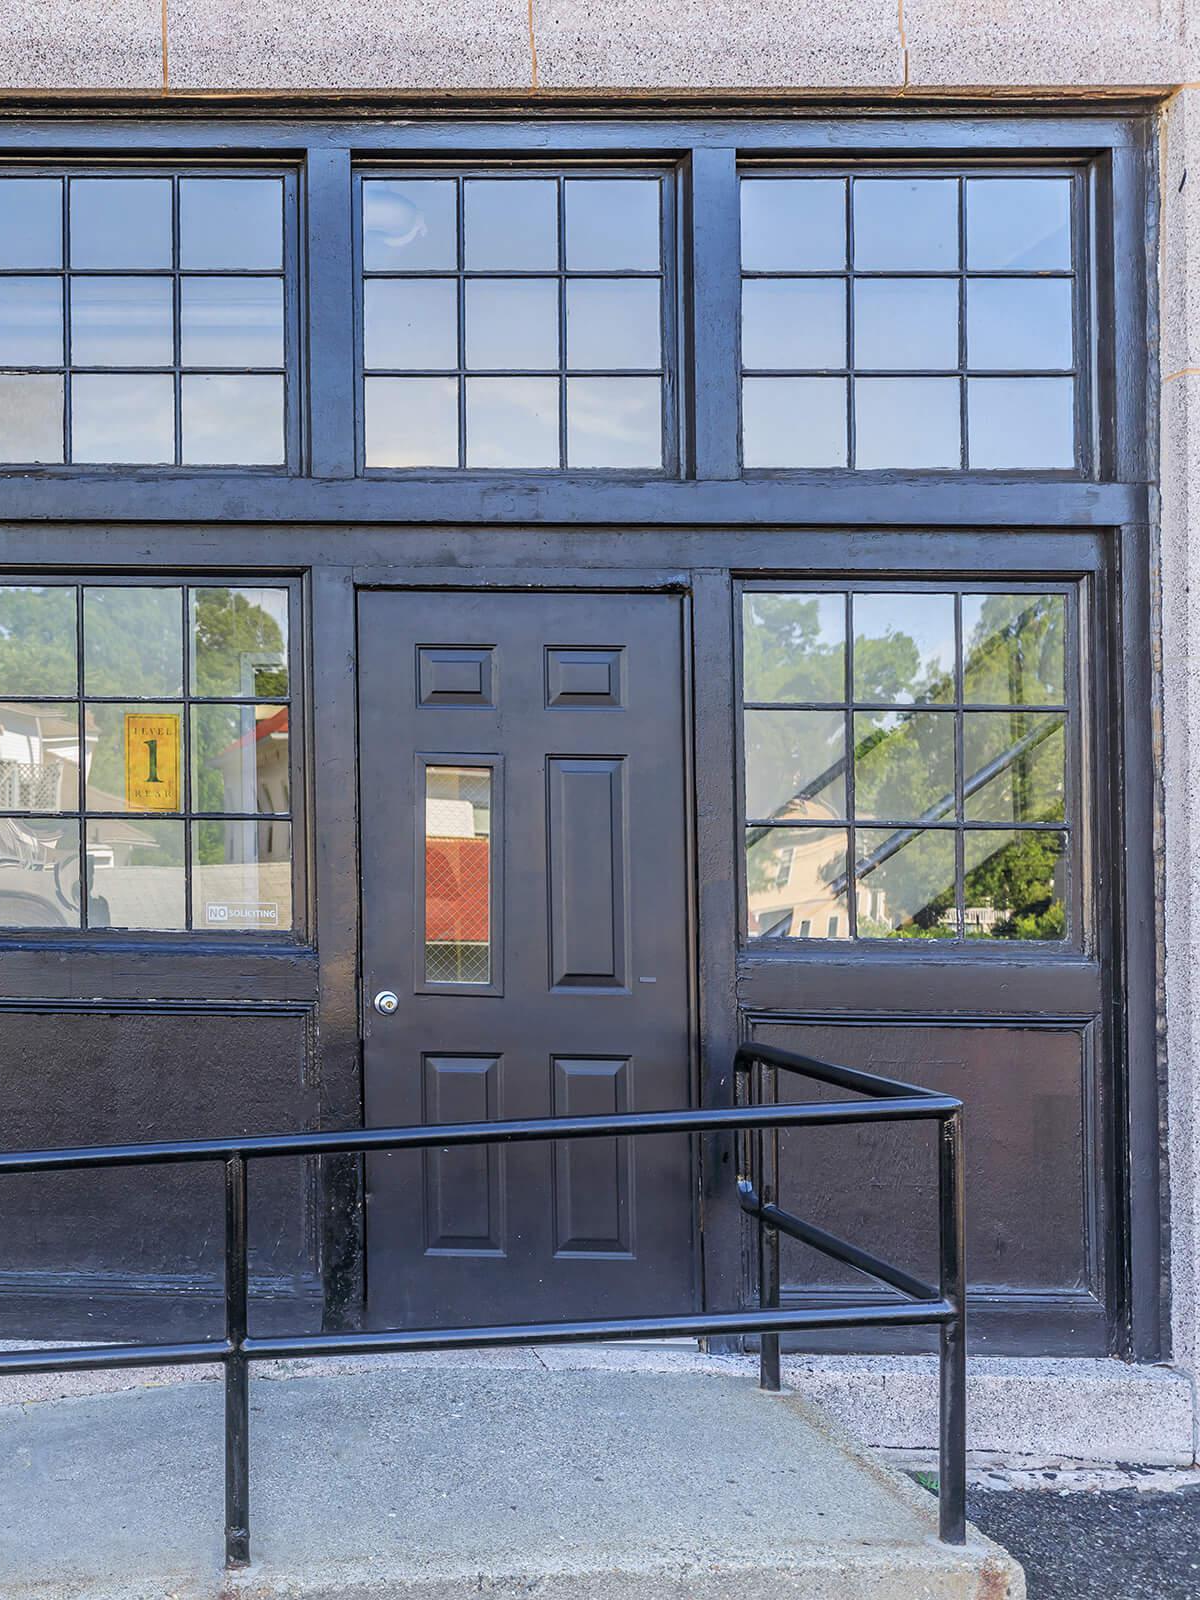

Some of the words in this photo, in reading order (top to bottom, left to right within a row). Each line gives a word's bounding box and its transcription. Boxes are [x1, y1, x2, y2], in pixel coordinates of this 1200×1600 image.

[143, 739, 164, 783] 1
[209, 908, 226, 918] NO
[229, 909, 276, 918] SOLICITING
